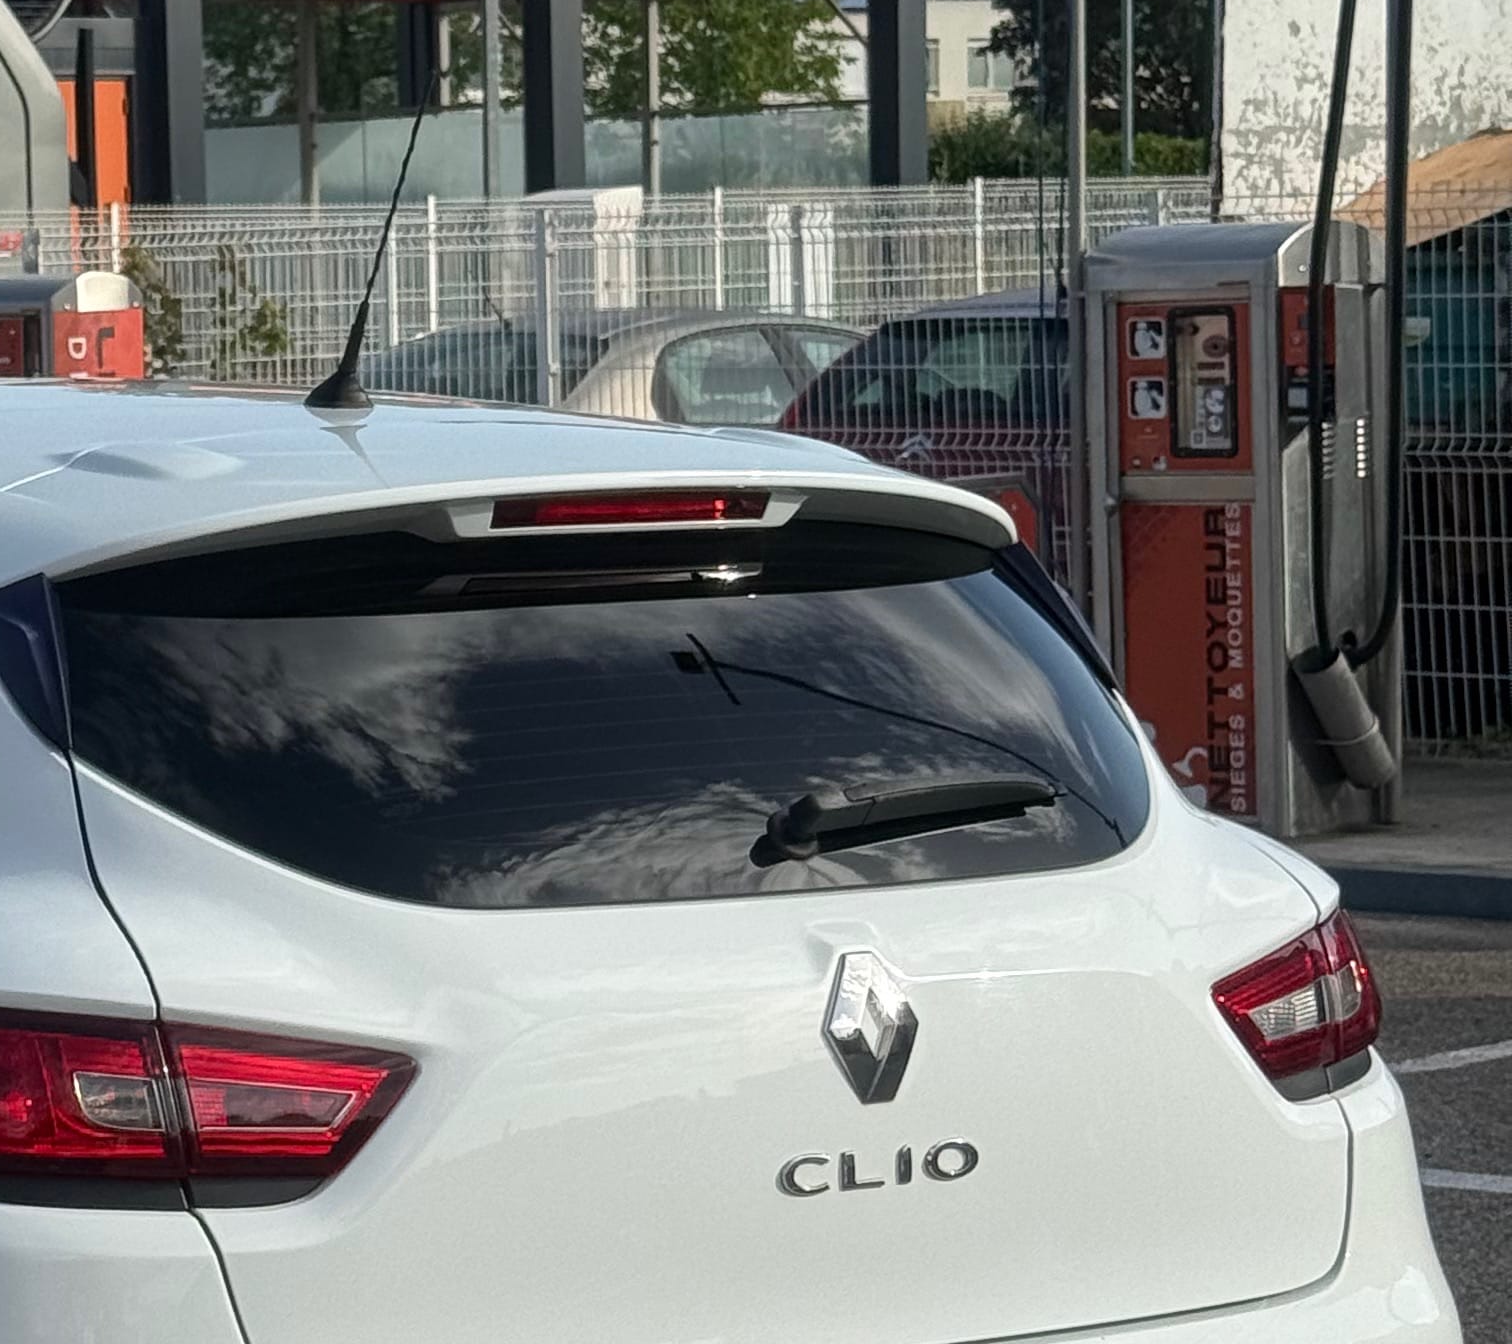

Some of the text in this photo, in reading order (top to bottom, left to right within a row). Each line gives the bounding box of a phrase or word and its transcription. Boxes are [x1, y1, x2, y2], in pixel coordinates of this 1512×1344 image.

[1204, 508, 1229, 811] NETTOYEUR
[1224, 502, 1246, 813] SIEGES & MOQUETTES
[775, 1137, 979, 1198] CLIO
